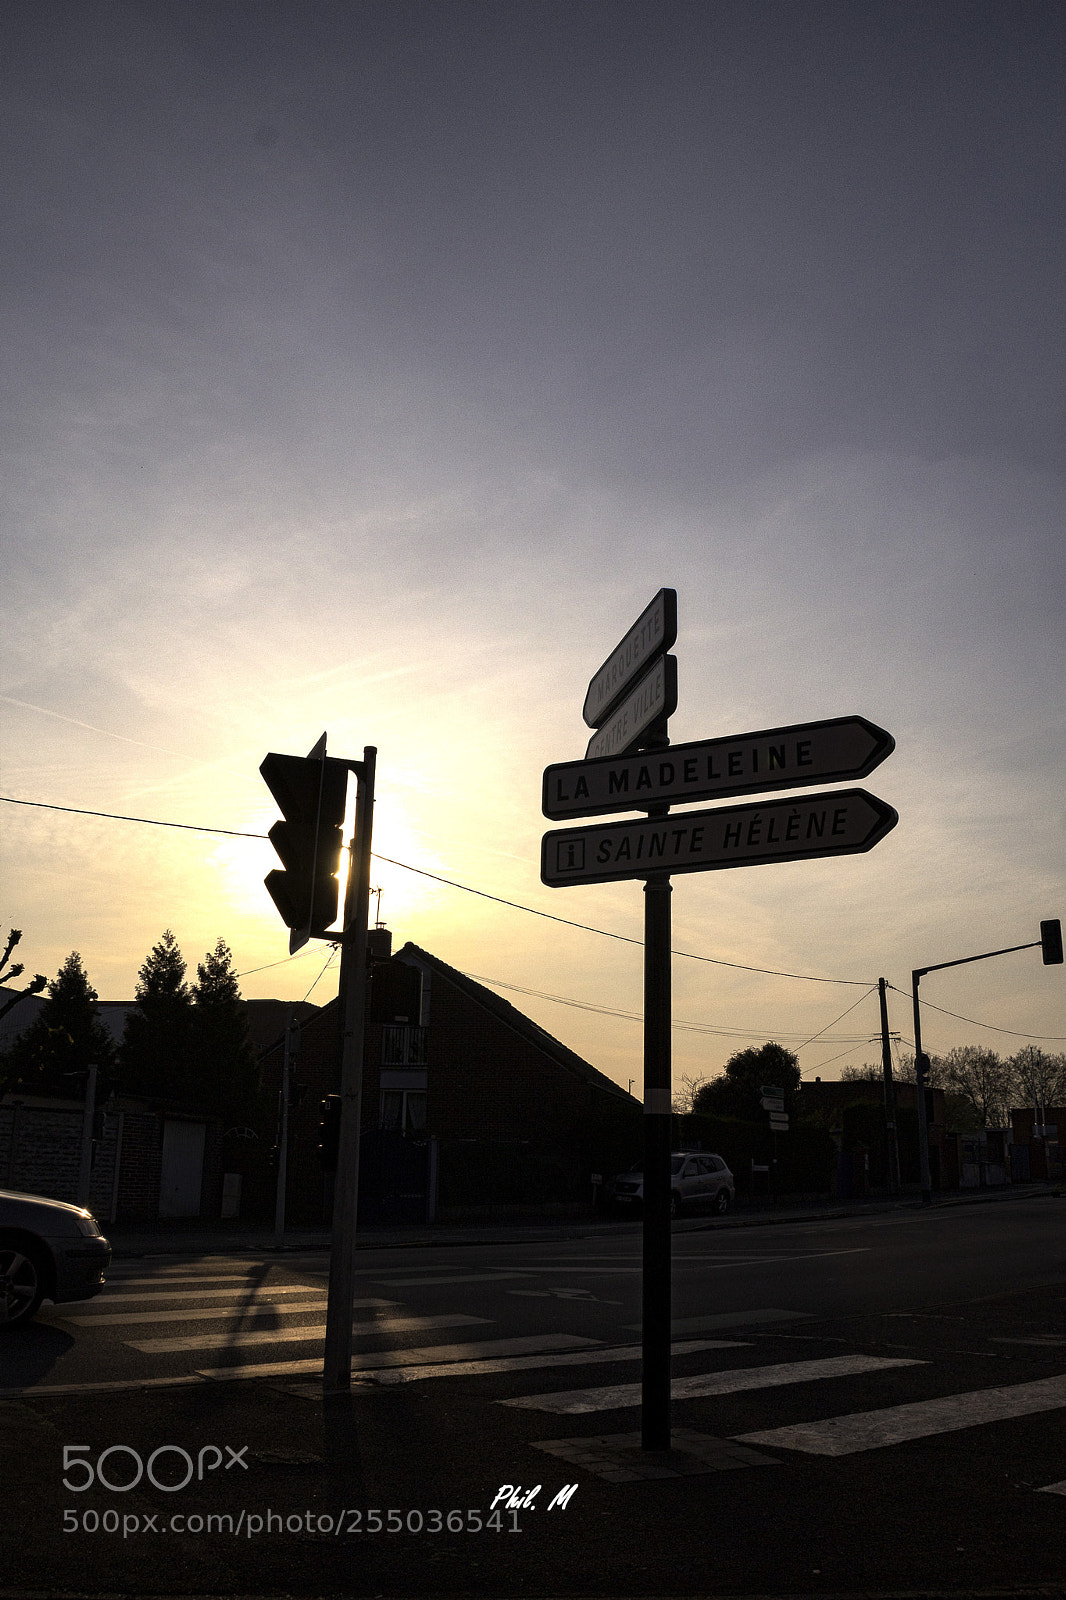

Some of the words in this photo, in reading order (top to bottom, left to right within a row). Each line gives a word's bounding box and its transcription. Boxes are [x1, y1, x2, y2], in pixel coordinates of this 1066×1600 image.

[596, 607, 661, 705] MARQUETTE
[633, 671, 662, 723] VILLE
[557, 775, 590, 802] LA
[608, 740, 813, 794] MADELEINE
[596, 826, 705, 864] SAINTE
[723, 808, 848, 849] HÉLÈNE
